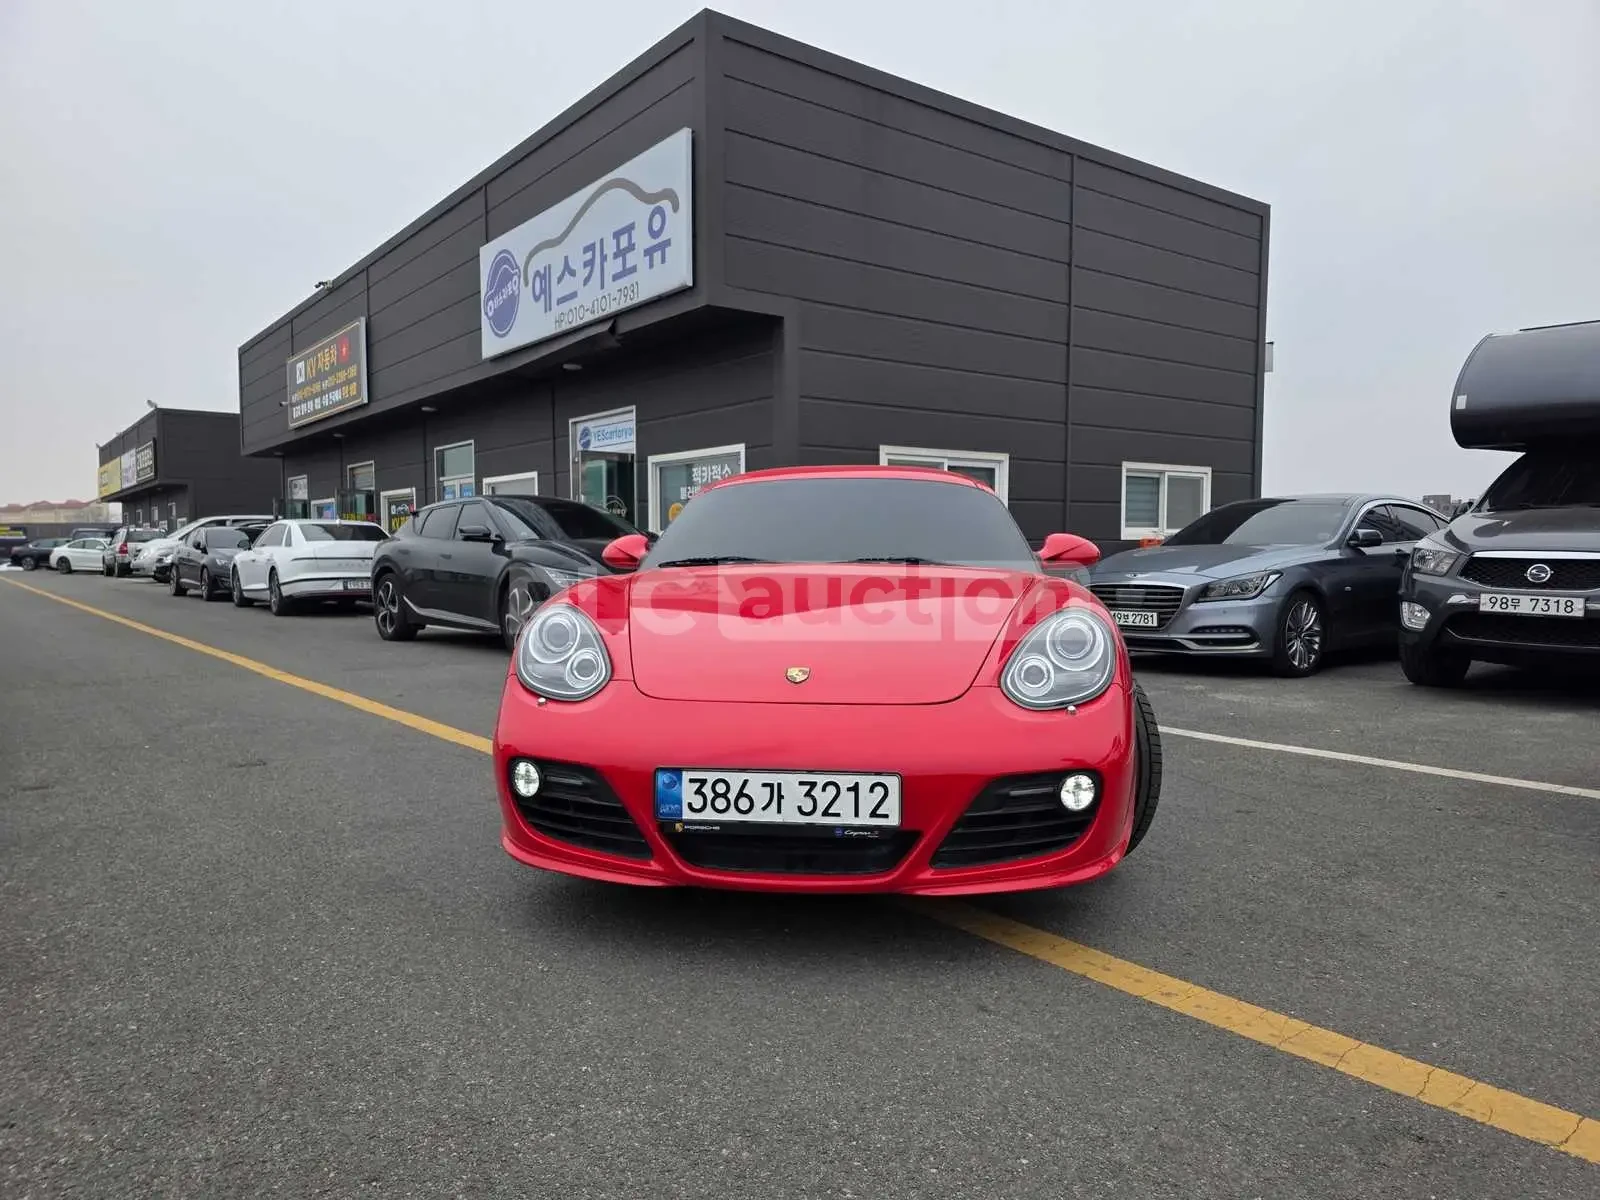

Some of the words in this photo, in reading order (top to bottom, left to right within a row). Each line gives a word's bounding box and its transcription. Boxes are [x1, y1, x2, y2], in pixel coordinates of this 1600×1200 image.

[532, 204, 671, 313] 예스카포유
[1131, 613, 1154, 625] 2781
[1488, 596, 1520, 610] 98무
[1529, 598, 1575, 614] 7318
[687, 778, 785, 815] 386가
[796, 780, 890, 818] 3212
